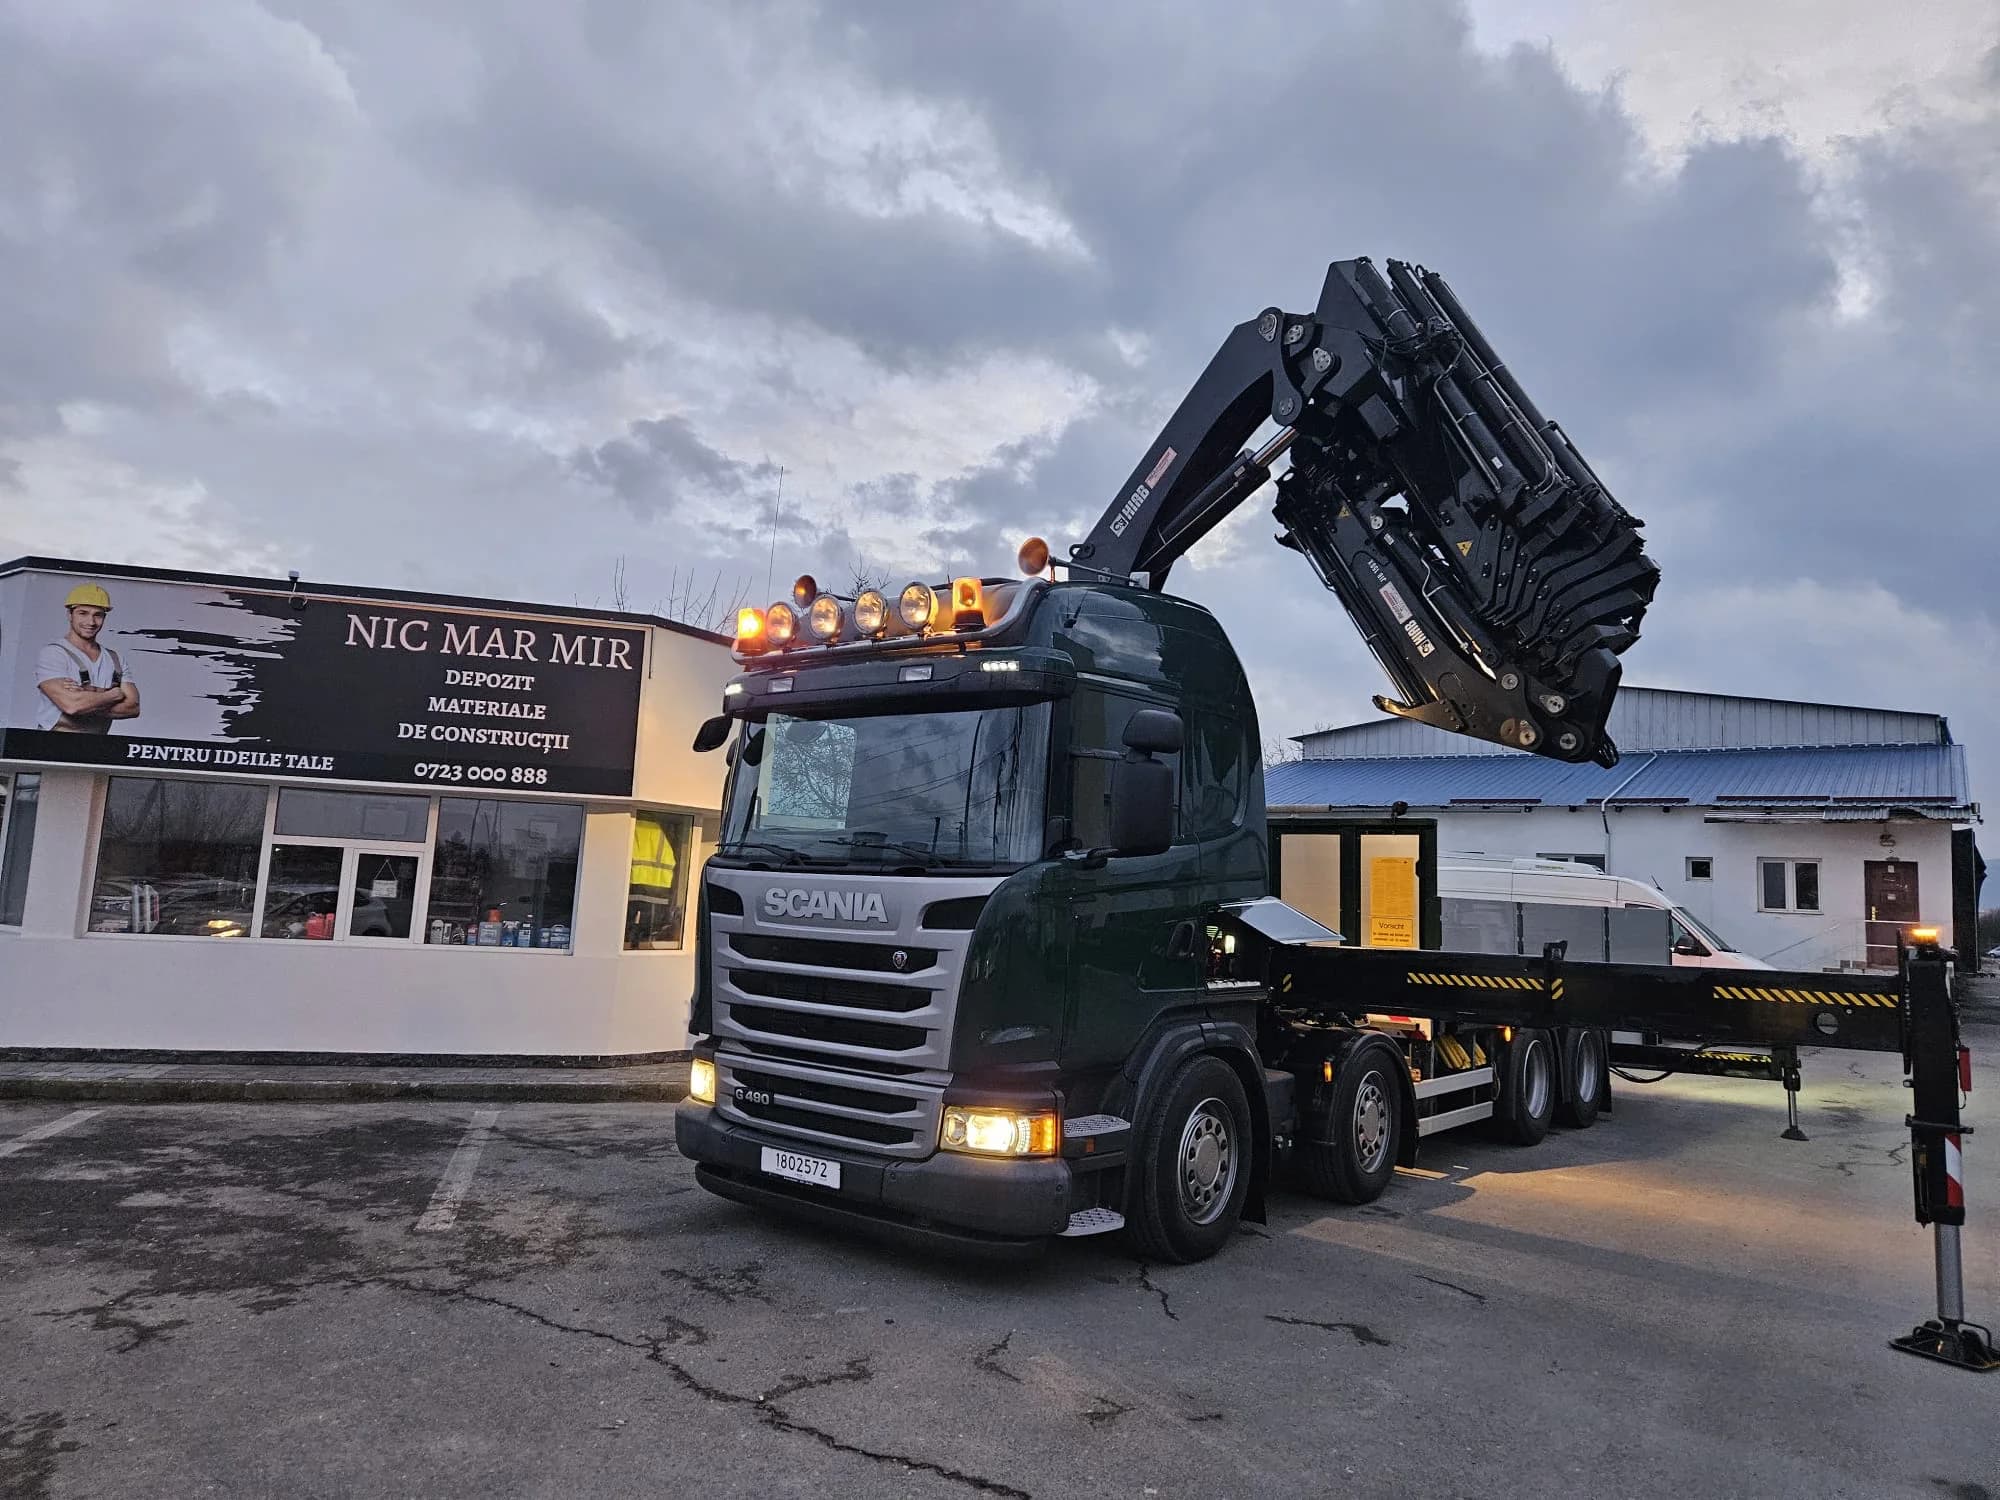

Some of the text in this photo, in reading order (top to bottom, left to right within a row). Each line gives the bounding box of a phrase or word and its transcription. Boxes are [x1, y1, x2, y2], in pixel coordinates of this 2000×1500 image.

[345, 614, 633, 670] NIC MAR MIR
[445, 669, 535, 691] DEPOZIT
[427, 697, 547, 720] MATERIALE
[398, 722, 570, 754] DE CONSTRUCȚII
[127, 743, 335, 771] PENTRU IDEILE TALE
[414, 763, 548, 785] 0723 000 888
[764, 887, 888, 923] SCANIA
[735, 1089, 769, 1105] G 490
[776, 1153, 827, 1178] 1802572
